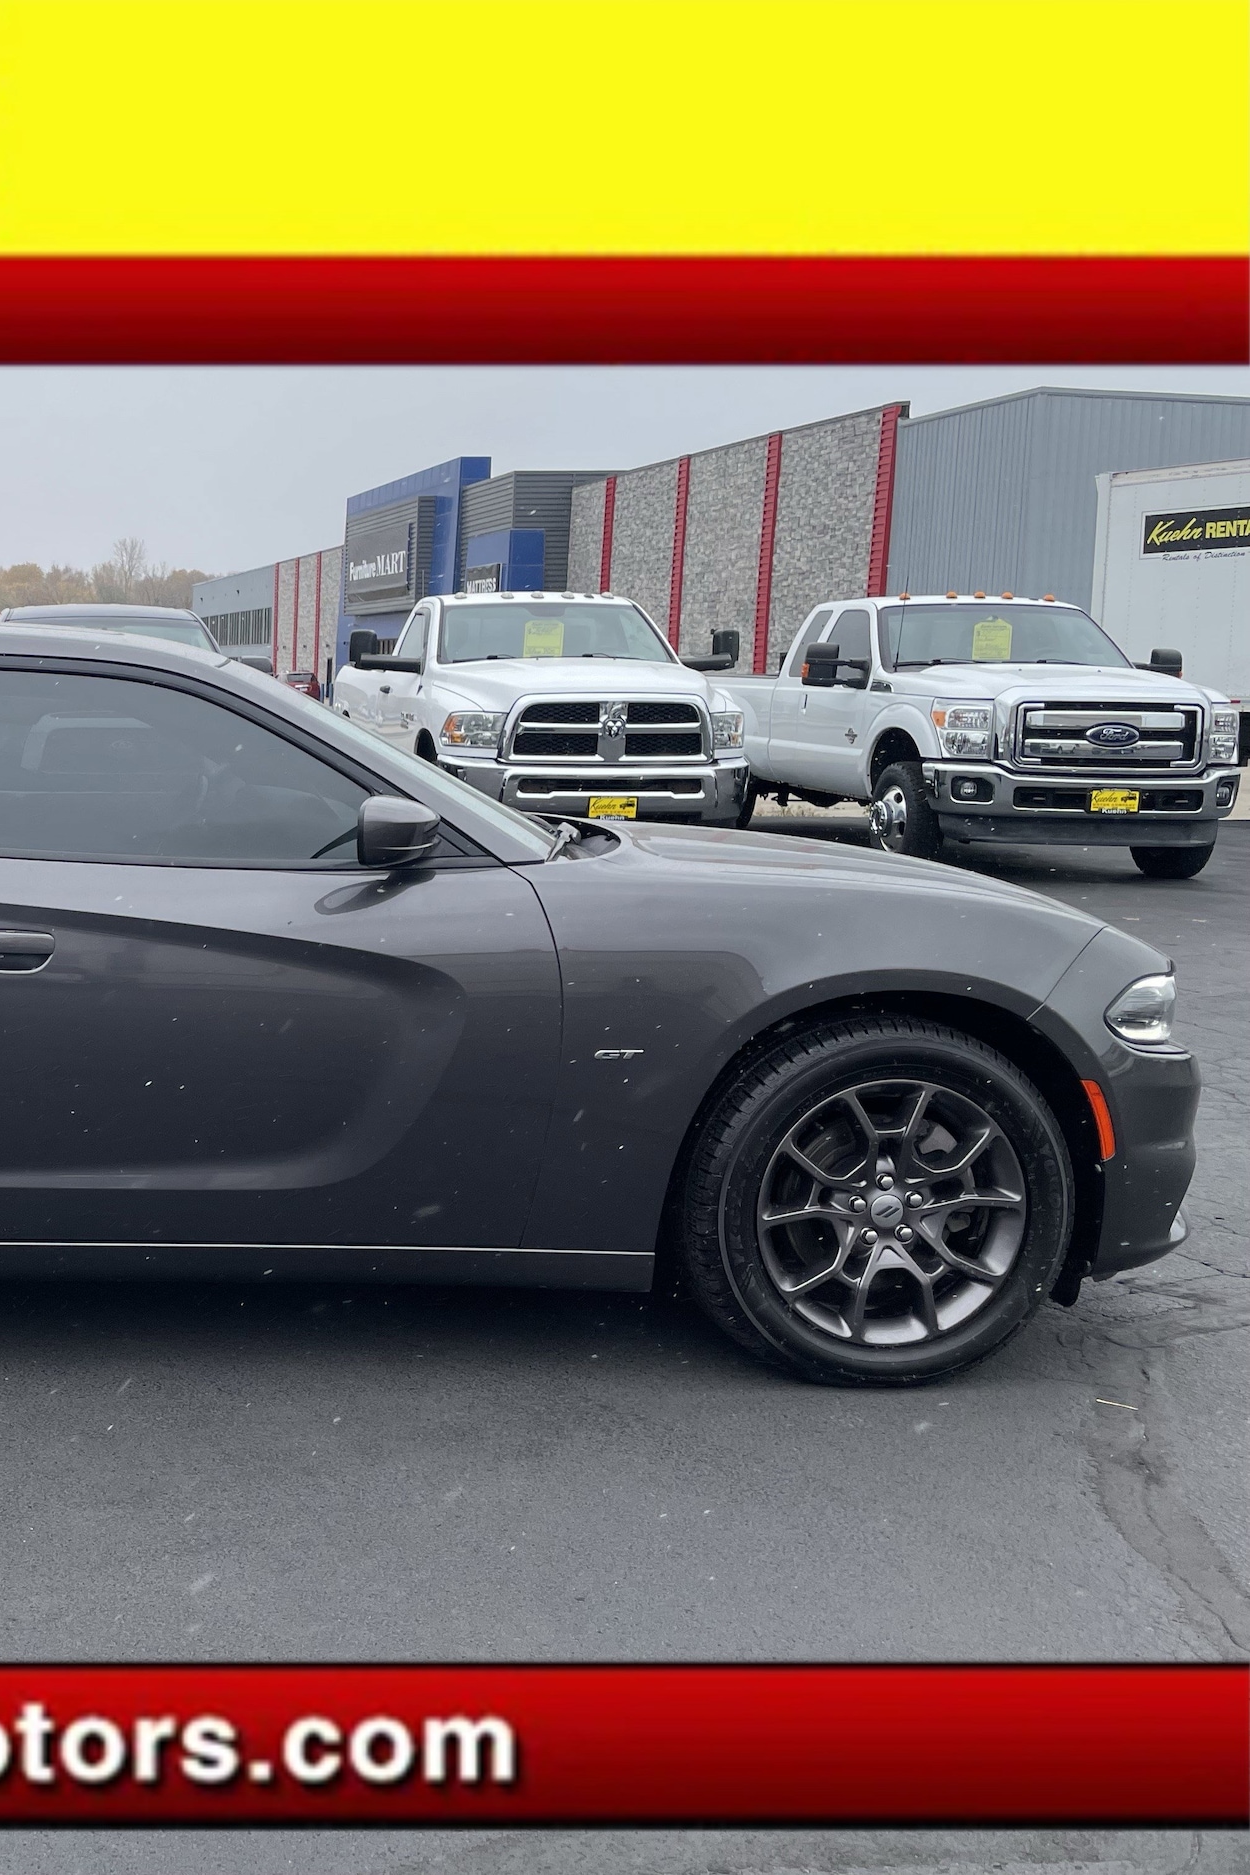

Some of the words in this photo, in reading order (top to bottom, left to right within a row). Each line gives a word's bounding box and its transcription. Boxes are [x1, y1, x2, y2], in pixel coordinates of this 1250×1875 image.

[1147, 518, 1203, 546] Kuehn
[1193, 553, 1200, 562] of
[1205, 551, 1246, 559] Distinction
[466, 577, 496, 594] MATTRESS
[1100, 728, 1129, 740] Ford
[1093, 791, 1118, 803] Kuehn
[591, 798, 617, 810] Kuehn
[594, 1049, 644, 1060] GT
